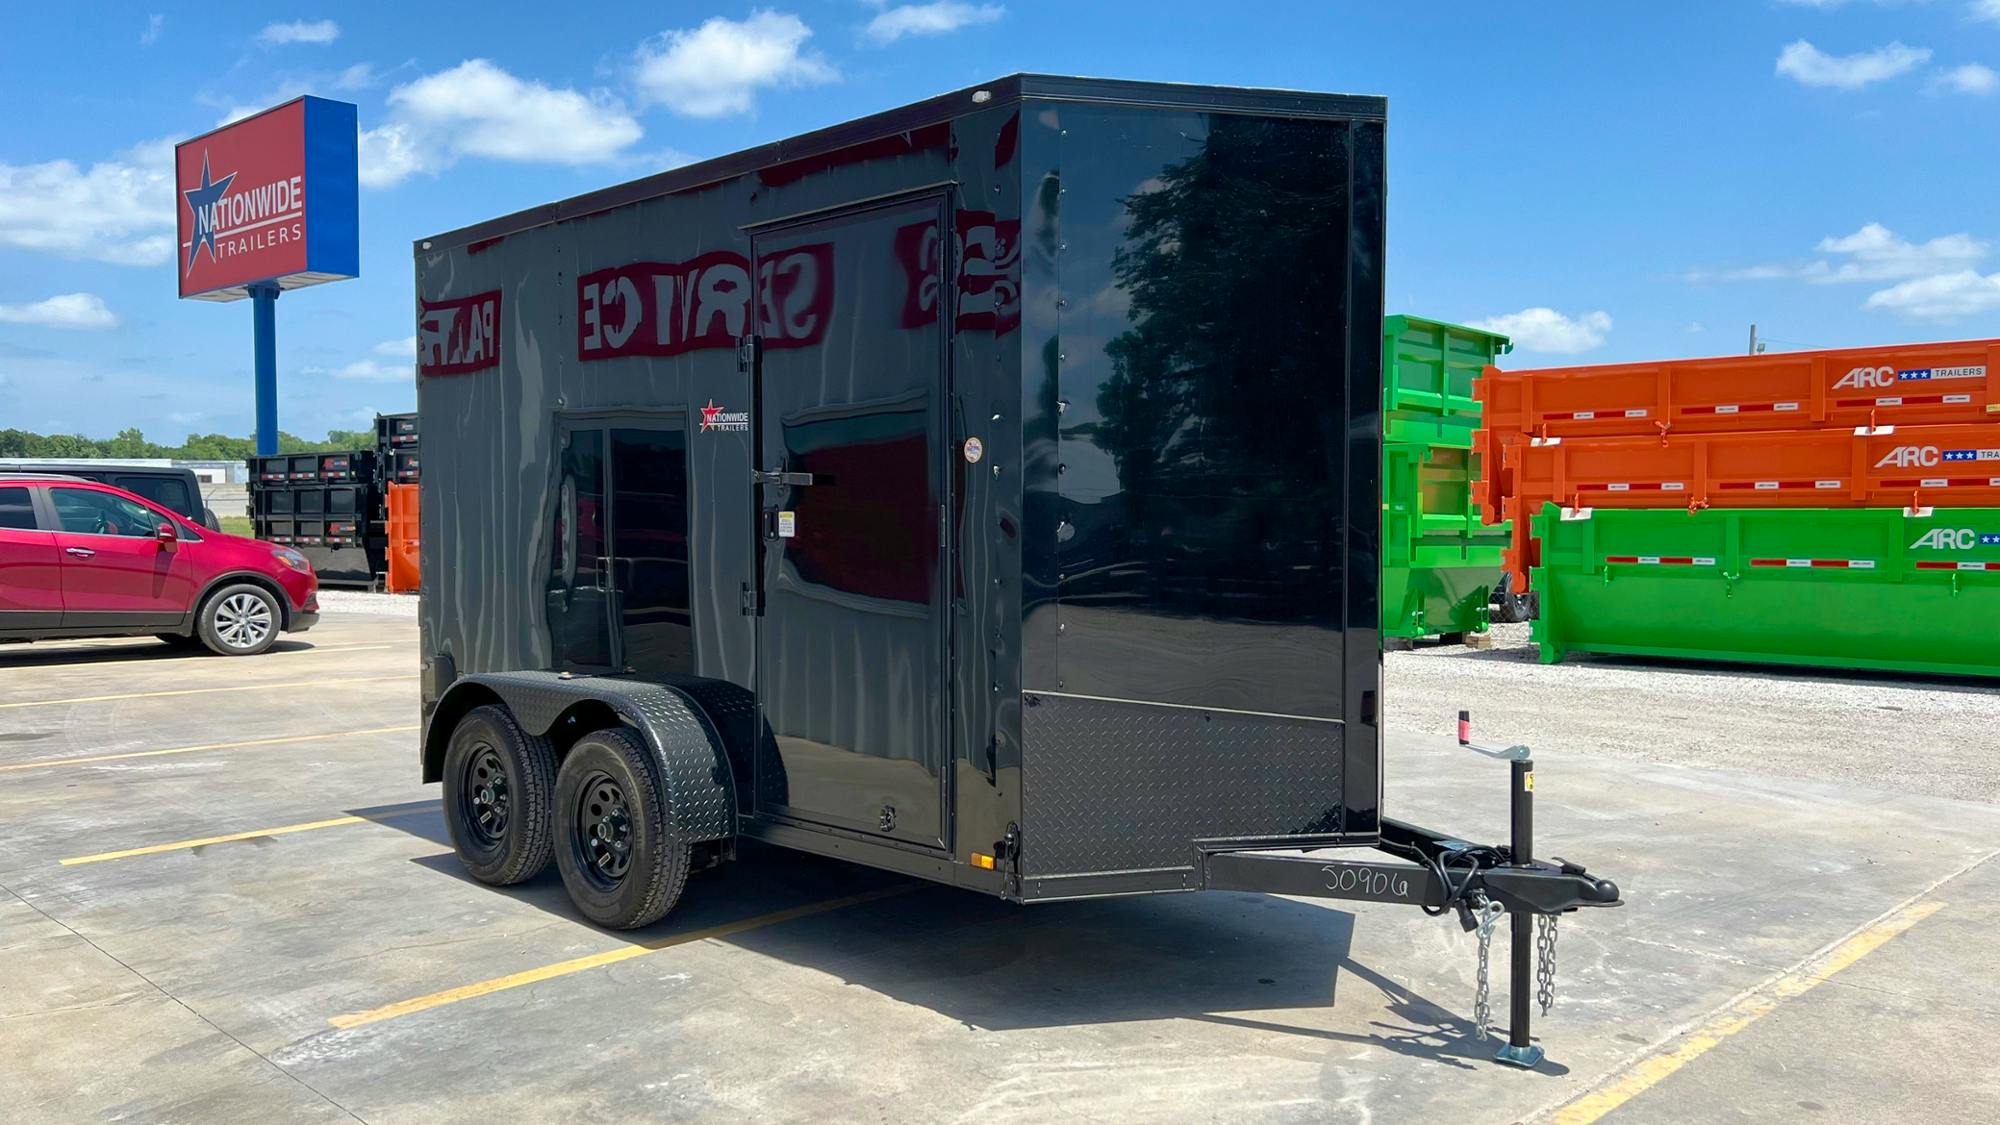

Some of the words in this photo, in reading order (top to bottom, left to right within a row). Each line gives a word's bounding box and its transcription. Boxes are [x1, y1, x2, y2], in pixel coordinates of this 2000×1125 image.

[198, 176, 303, 235] NATIONWIDE
[217, 223, 302, 259] TRAILERS
[1832, 366, 1895, 389] ARC
[1935, 367, 1983, 378] TRAILERS
[706, 412, 749, 422] NATIONWIDE
[717, 424, 749, 432] TRAILERS
[1873, 446, 1939, 468] ARC
[1908, 528, 1976, 550] ARC
[1321, 864, 1408, 898] 50906
